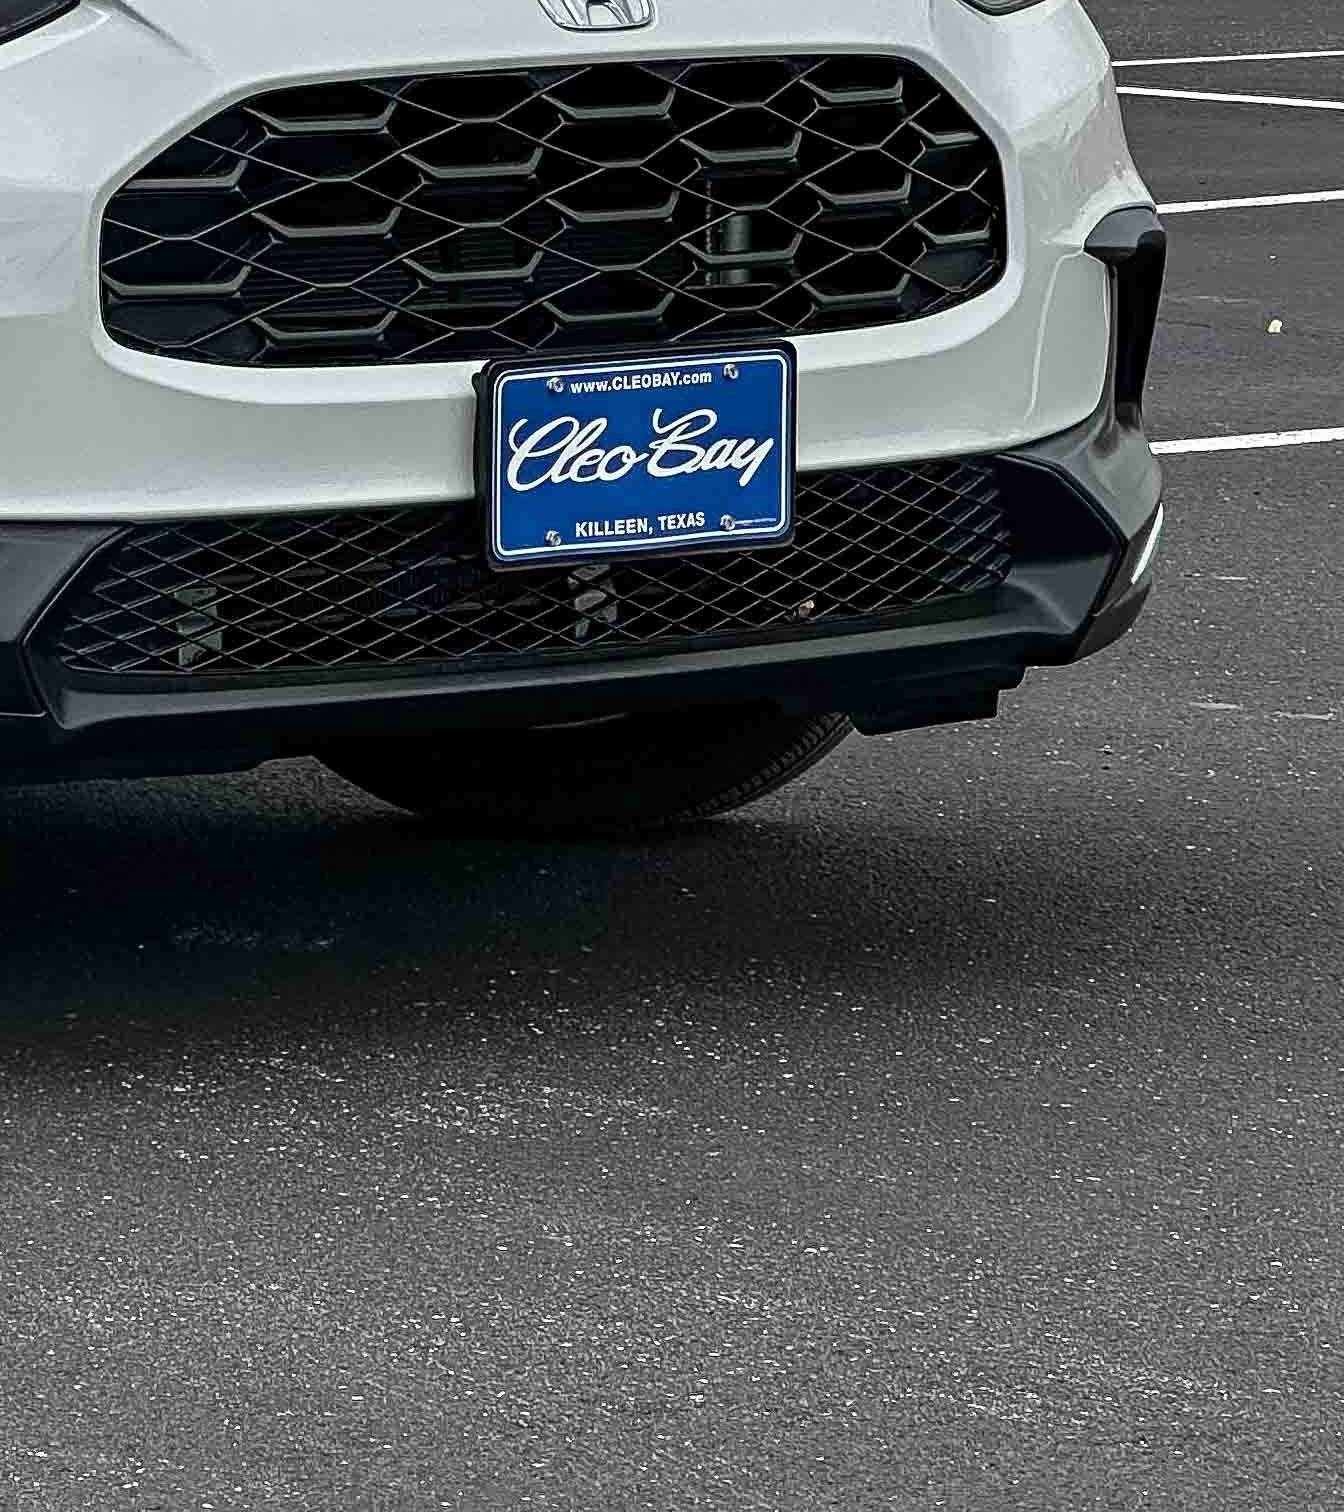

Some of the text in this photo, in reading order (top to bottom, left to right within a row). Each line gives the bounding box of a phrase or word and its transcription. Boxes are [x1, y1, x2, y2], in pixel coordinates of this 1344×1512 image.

[570, 371, 713, 395] www.CLEOBAY.com
[507, 407, 775, 492] Cleo Bay
[575, 511, 706, 538] KILLEEN, TEXAS
